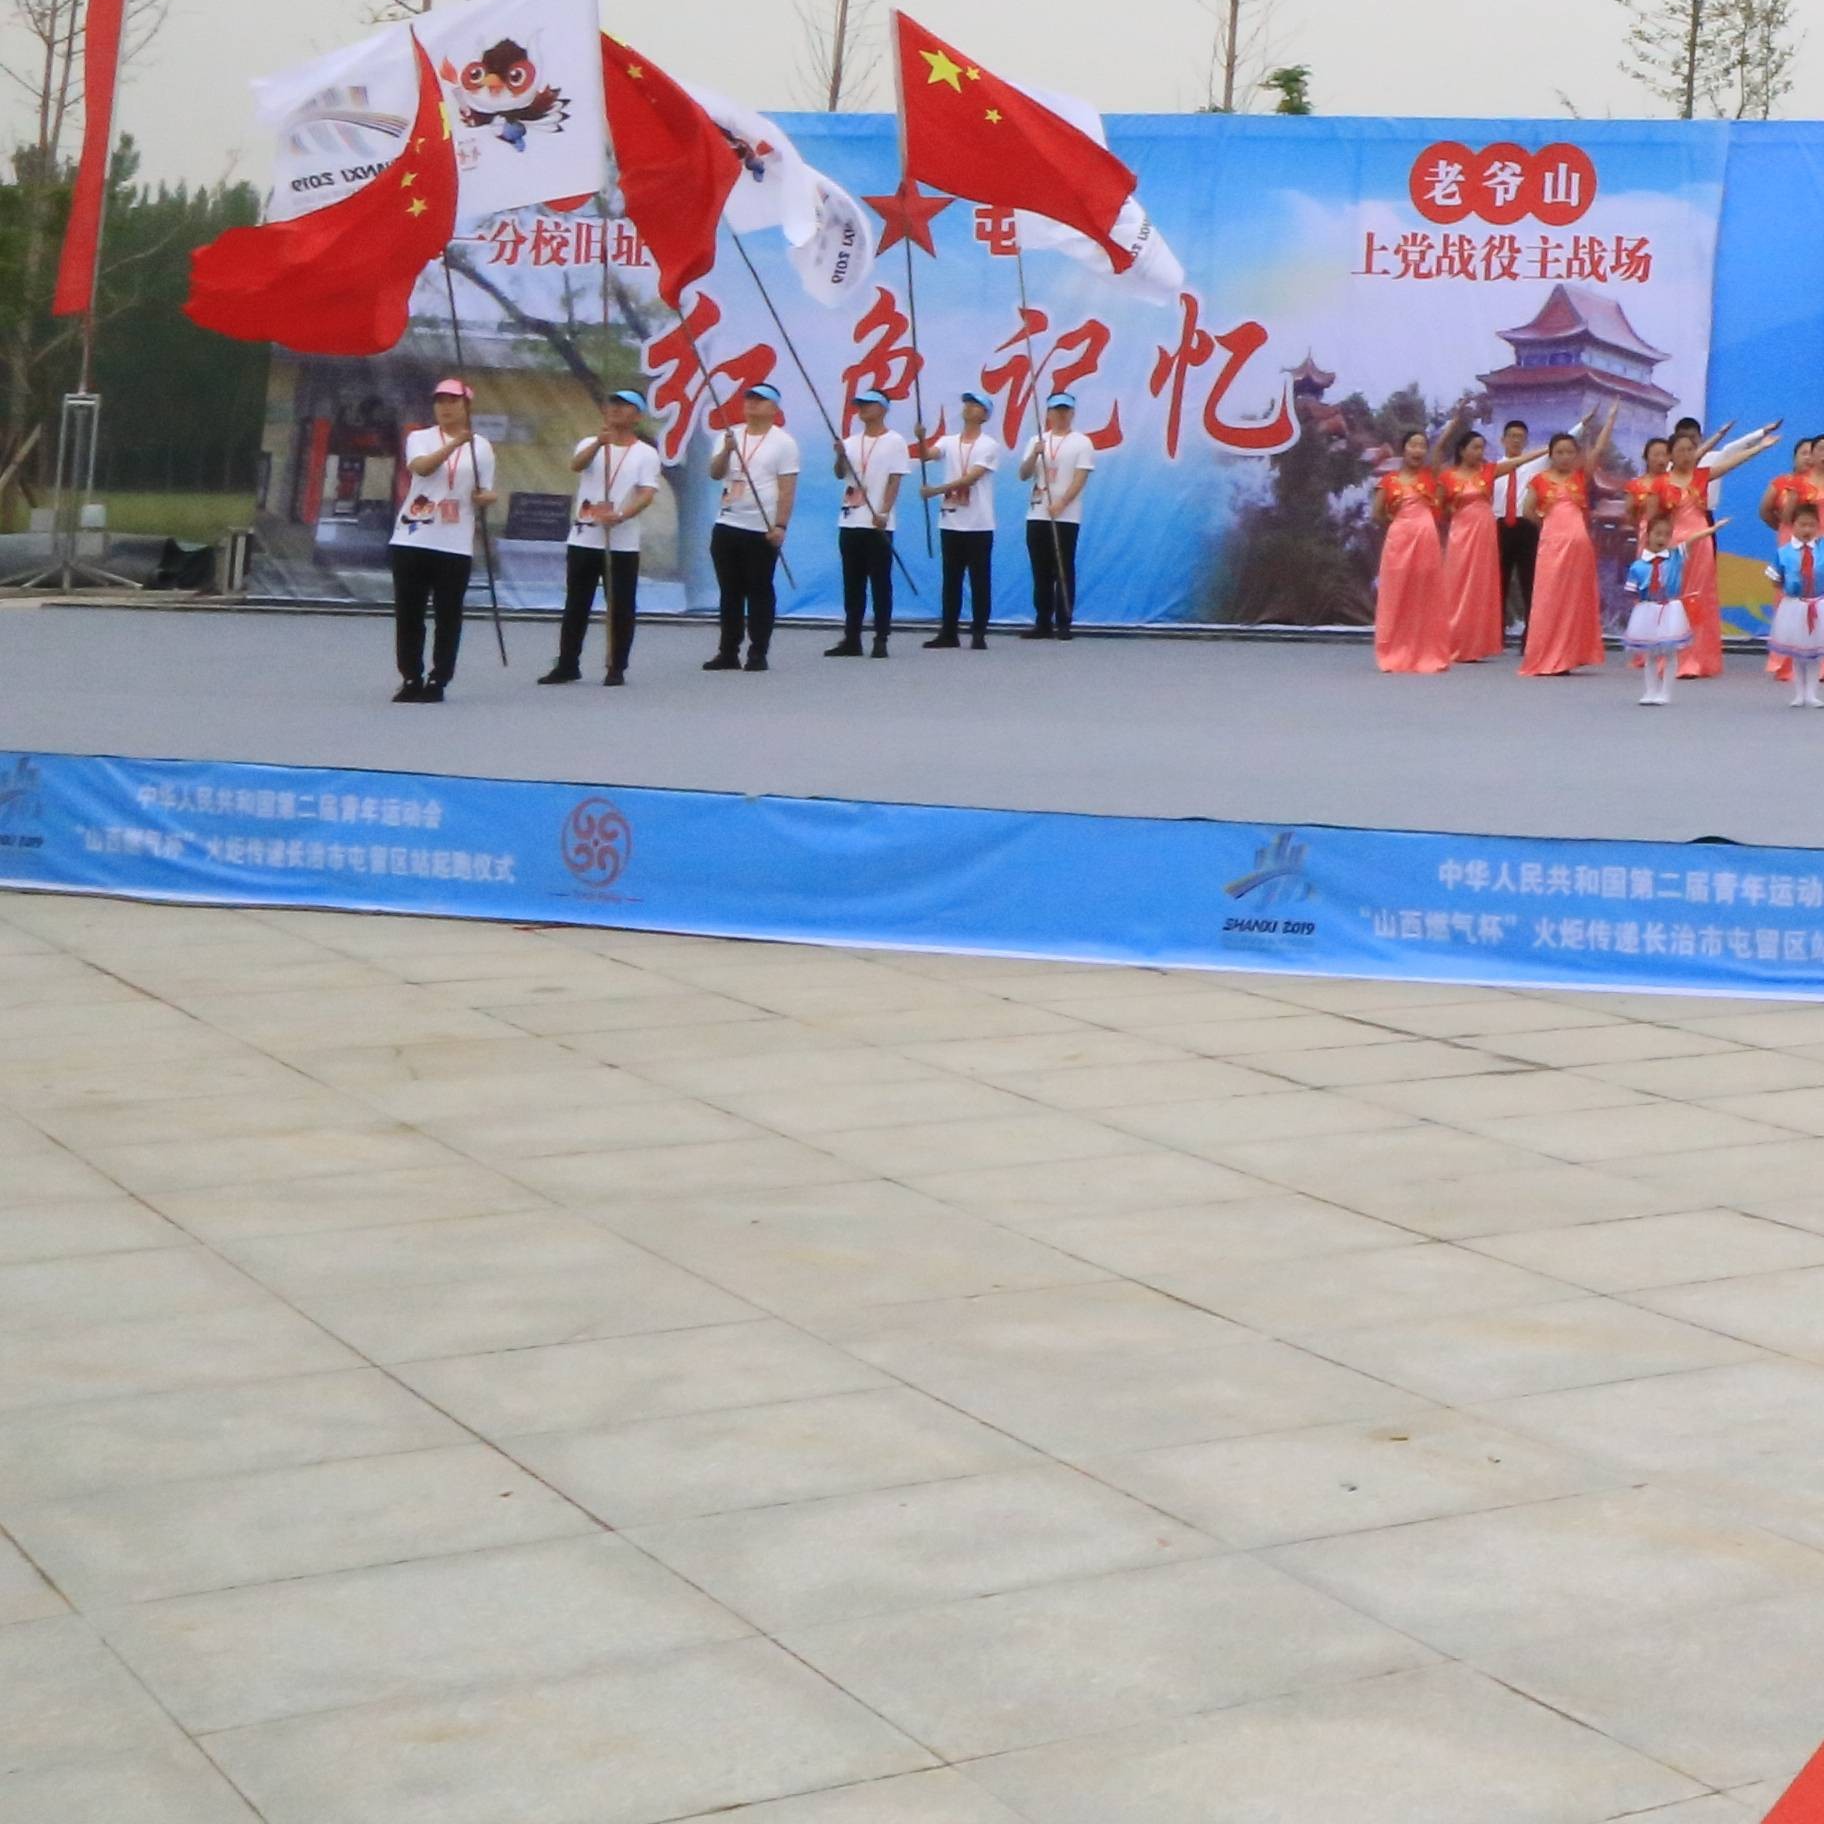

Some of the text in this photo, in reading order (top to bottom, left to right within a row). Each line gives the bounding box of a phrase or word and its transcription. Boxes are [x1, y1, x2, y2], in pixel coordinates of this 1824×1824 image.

[1423, 159, 1582, 207] 老爷山
[1351, 231, 1653, 284] 上党战役主战场
[1283, 920, 1316, 936] 2019
